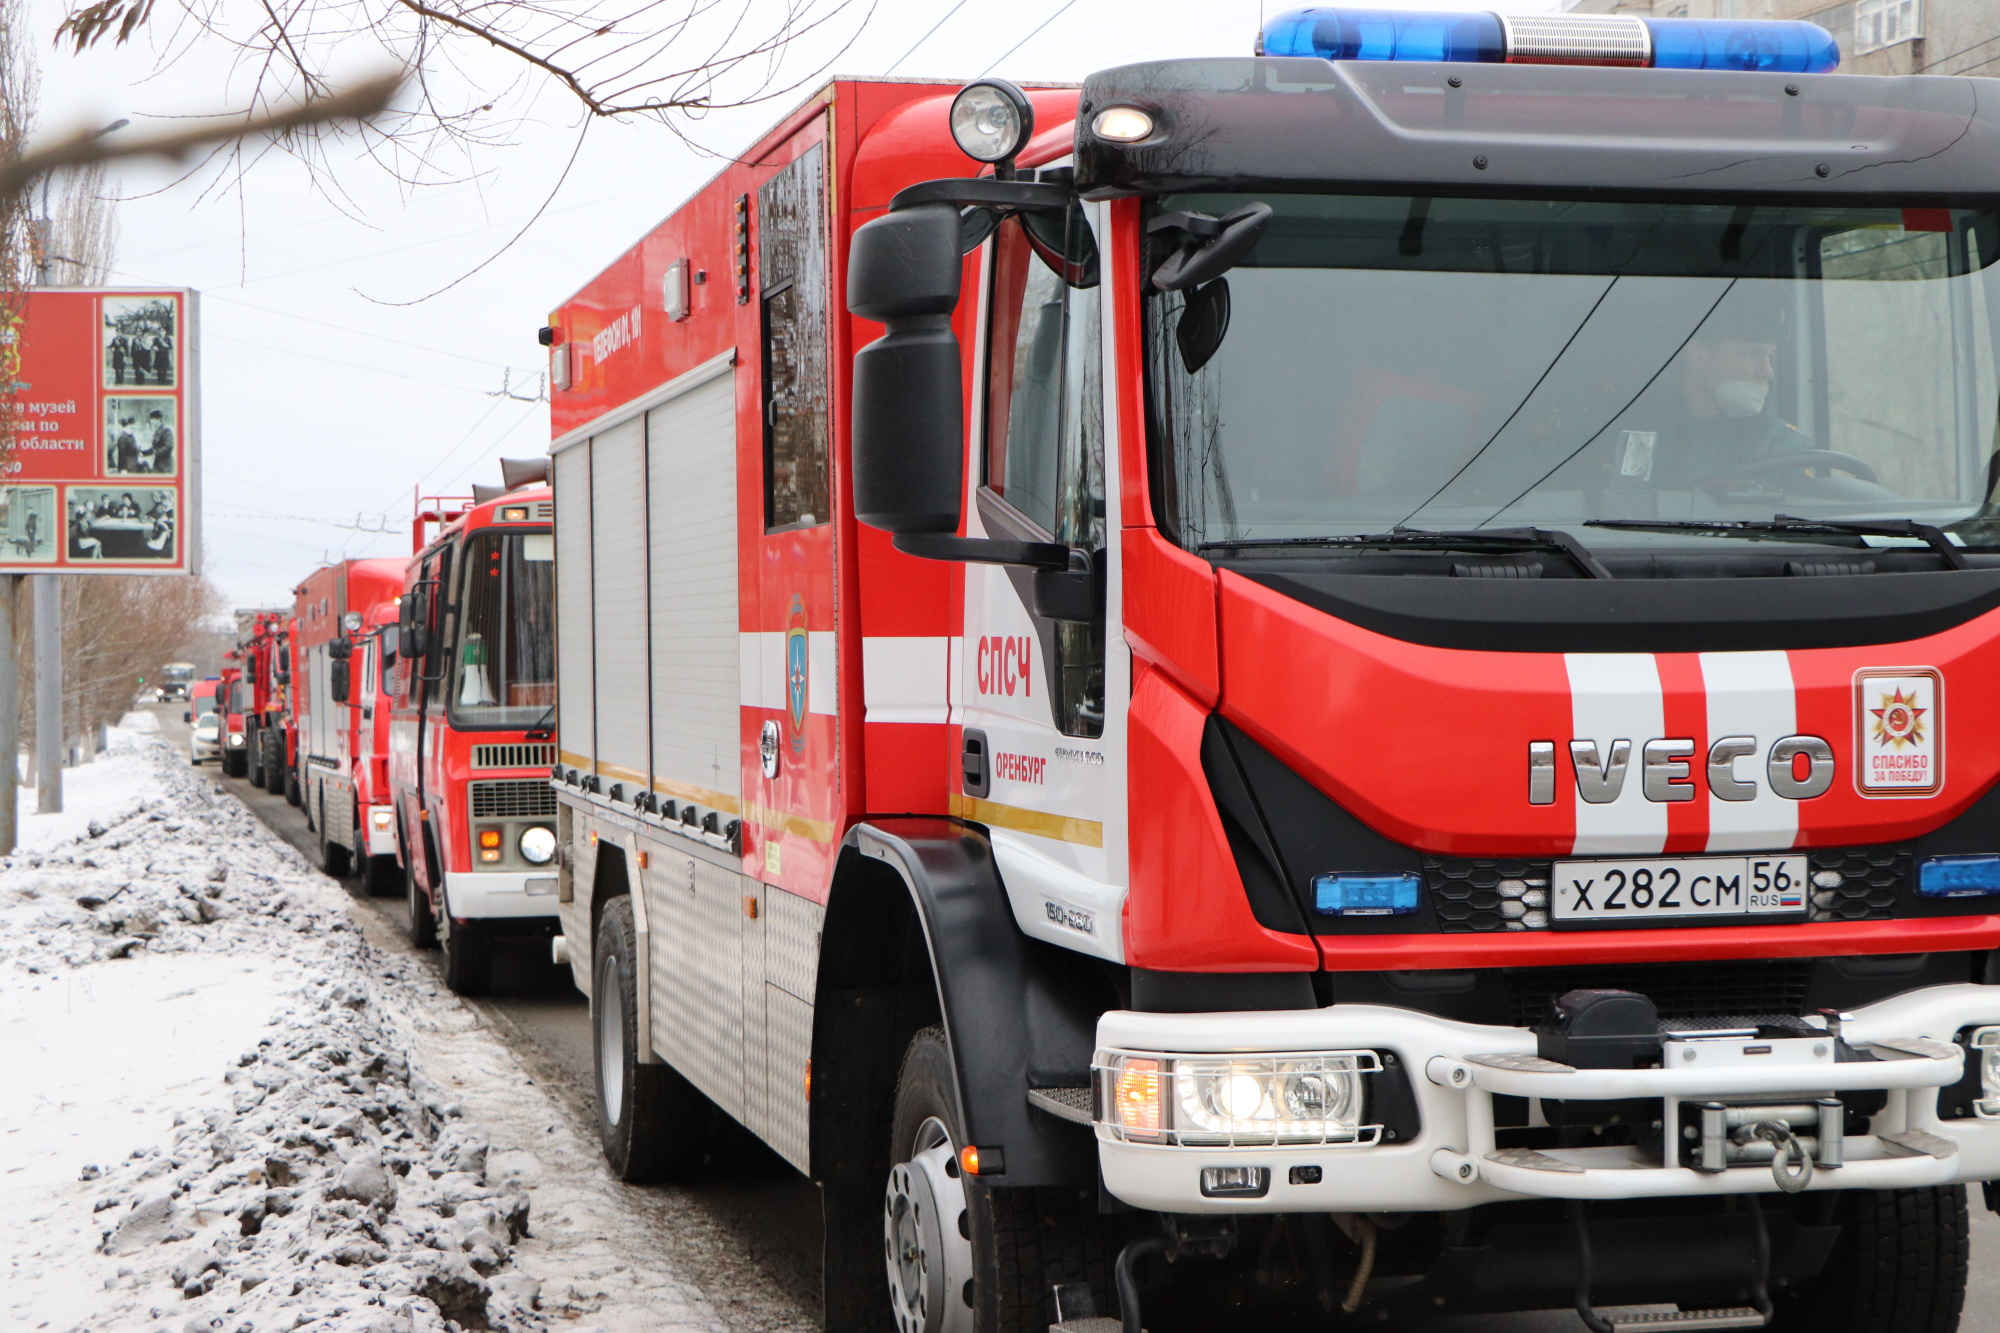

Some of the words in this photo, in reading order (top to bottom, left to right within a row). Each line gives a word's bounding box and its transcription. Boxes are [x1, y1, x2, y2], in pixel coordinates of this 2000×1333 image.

[593, 316, 621, 366] ТЕЛЕФОН
[631, 304, 642, 340] 101
[29, 400, 76, 417] музей
[40, 420, 59, 432] по
[20, 436, 85, 450] области
[977, 635, 1031, 697] СПСЧ
[995, 751, 1046, 785] ОРЕНБУРГ
[1528, 735, 1836, 806] IVECO
[1872, 755, 1929, 769] СПАСИБО
[1873, 771, 1886, 782] ЗА
[1888, 770, 1928, 783] ПОБЕДУ!
[1752, 861, 1792, 893] 56
[1750, 894, 1779, 907] RUS
